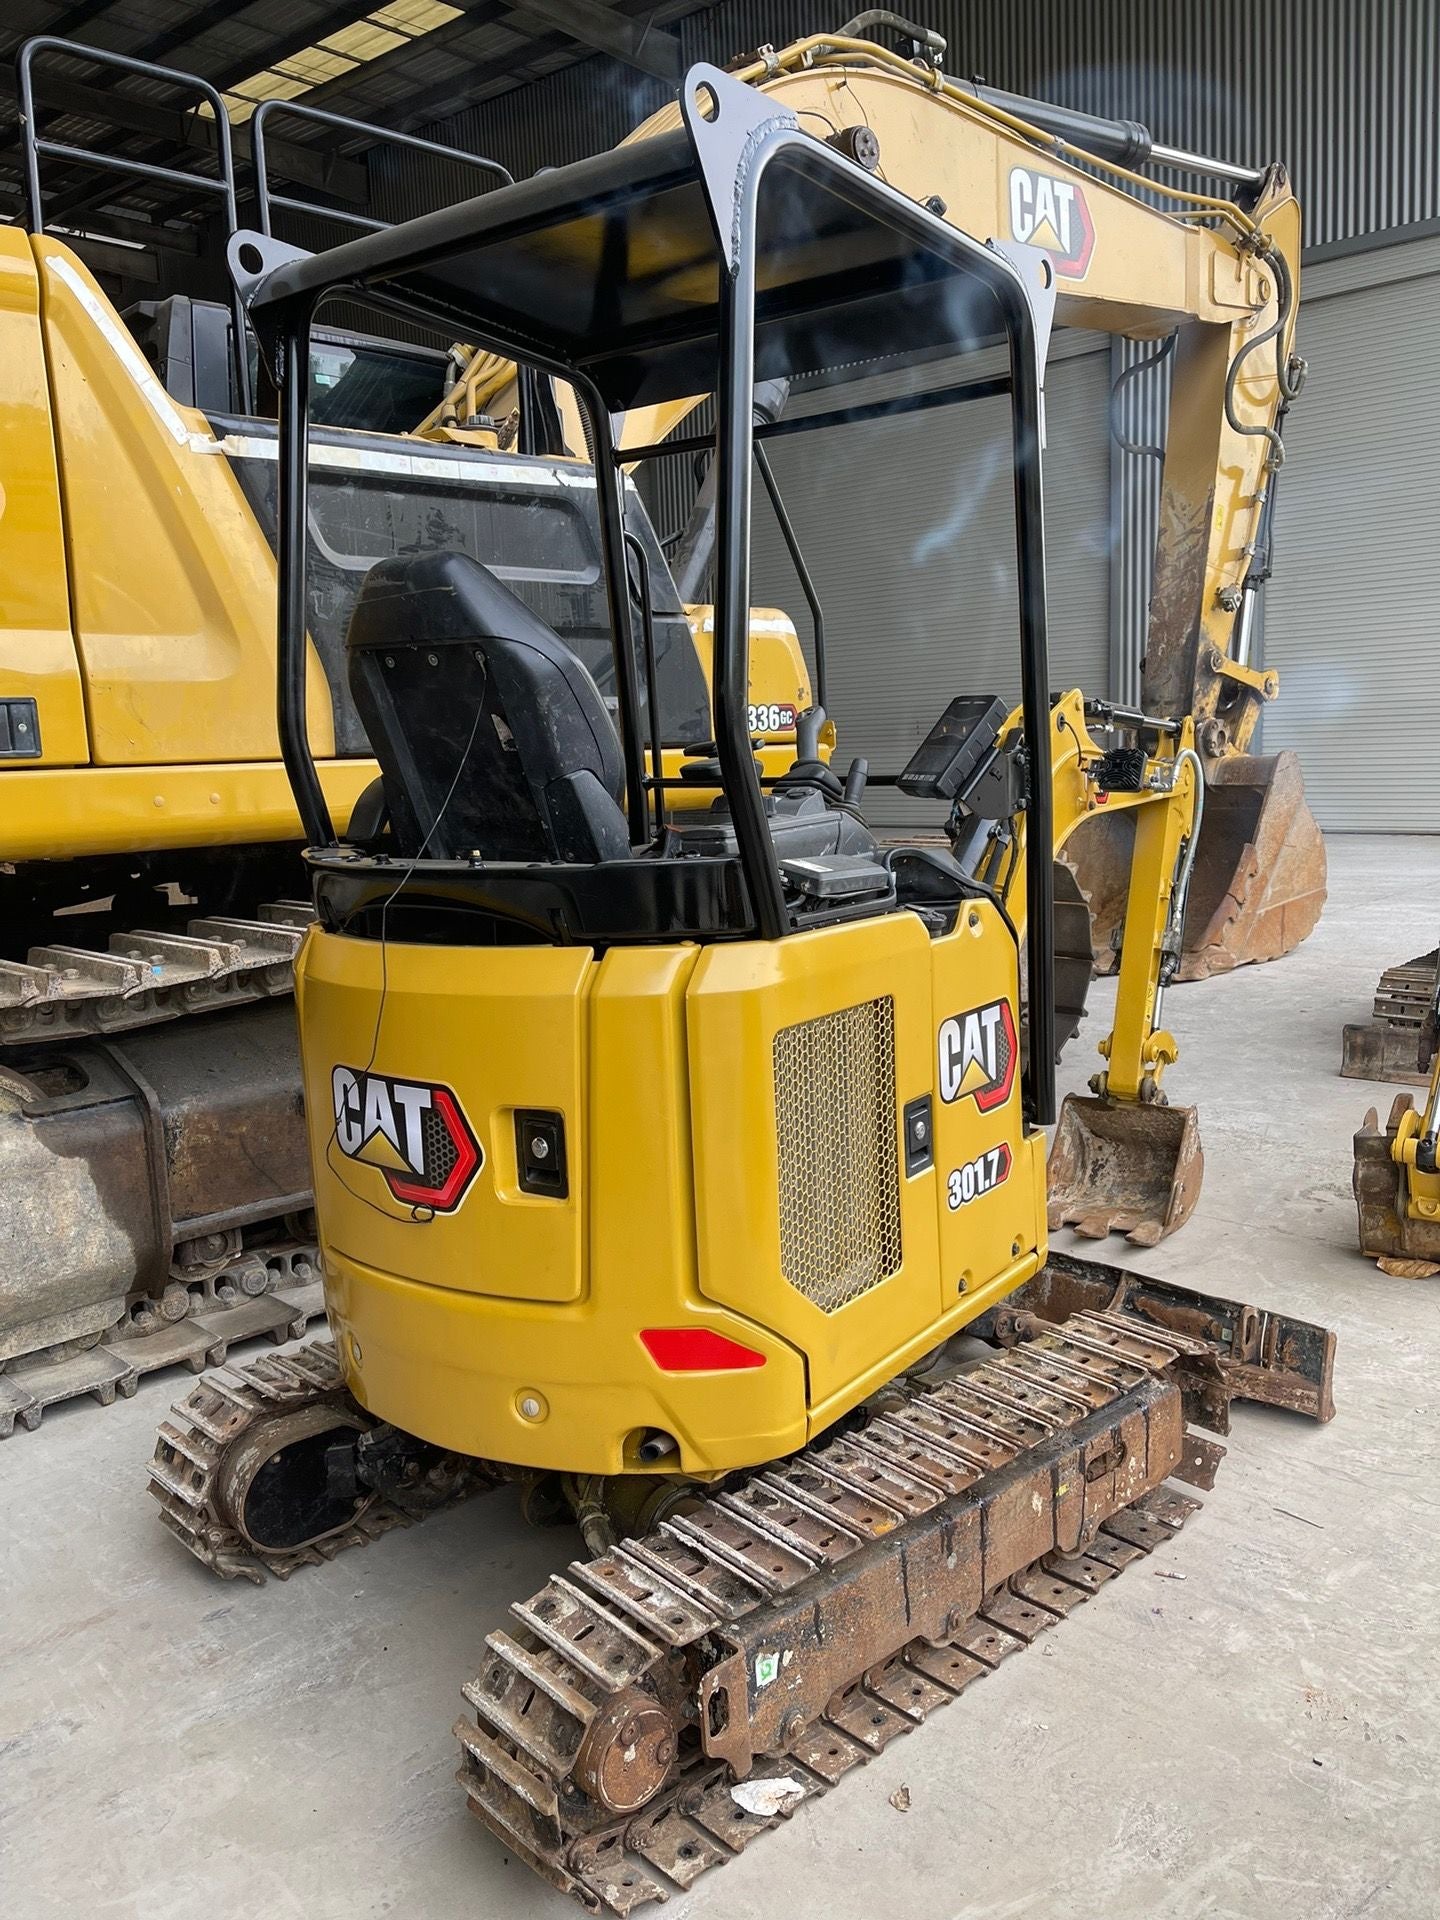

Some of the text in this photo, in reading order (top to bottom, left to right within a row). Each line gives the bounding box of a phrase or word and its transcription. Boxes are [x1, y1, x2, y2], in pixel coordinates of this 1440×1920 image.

[1010, 167, 1074, 255] CAT
[748, 704, 793, 731] 336 GC
[940, 1004, 1001, 1101] CAT
[333, 1066, 432, 1176] CAT
[948, 1147, 1000, 1208] 301.7
